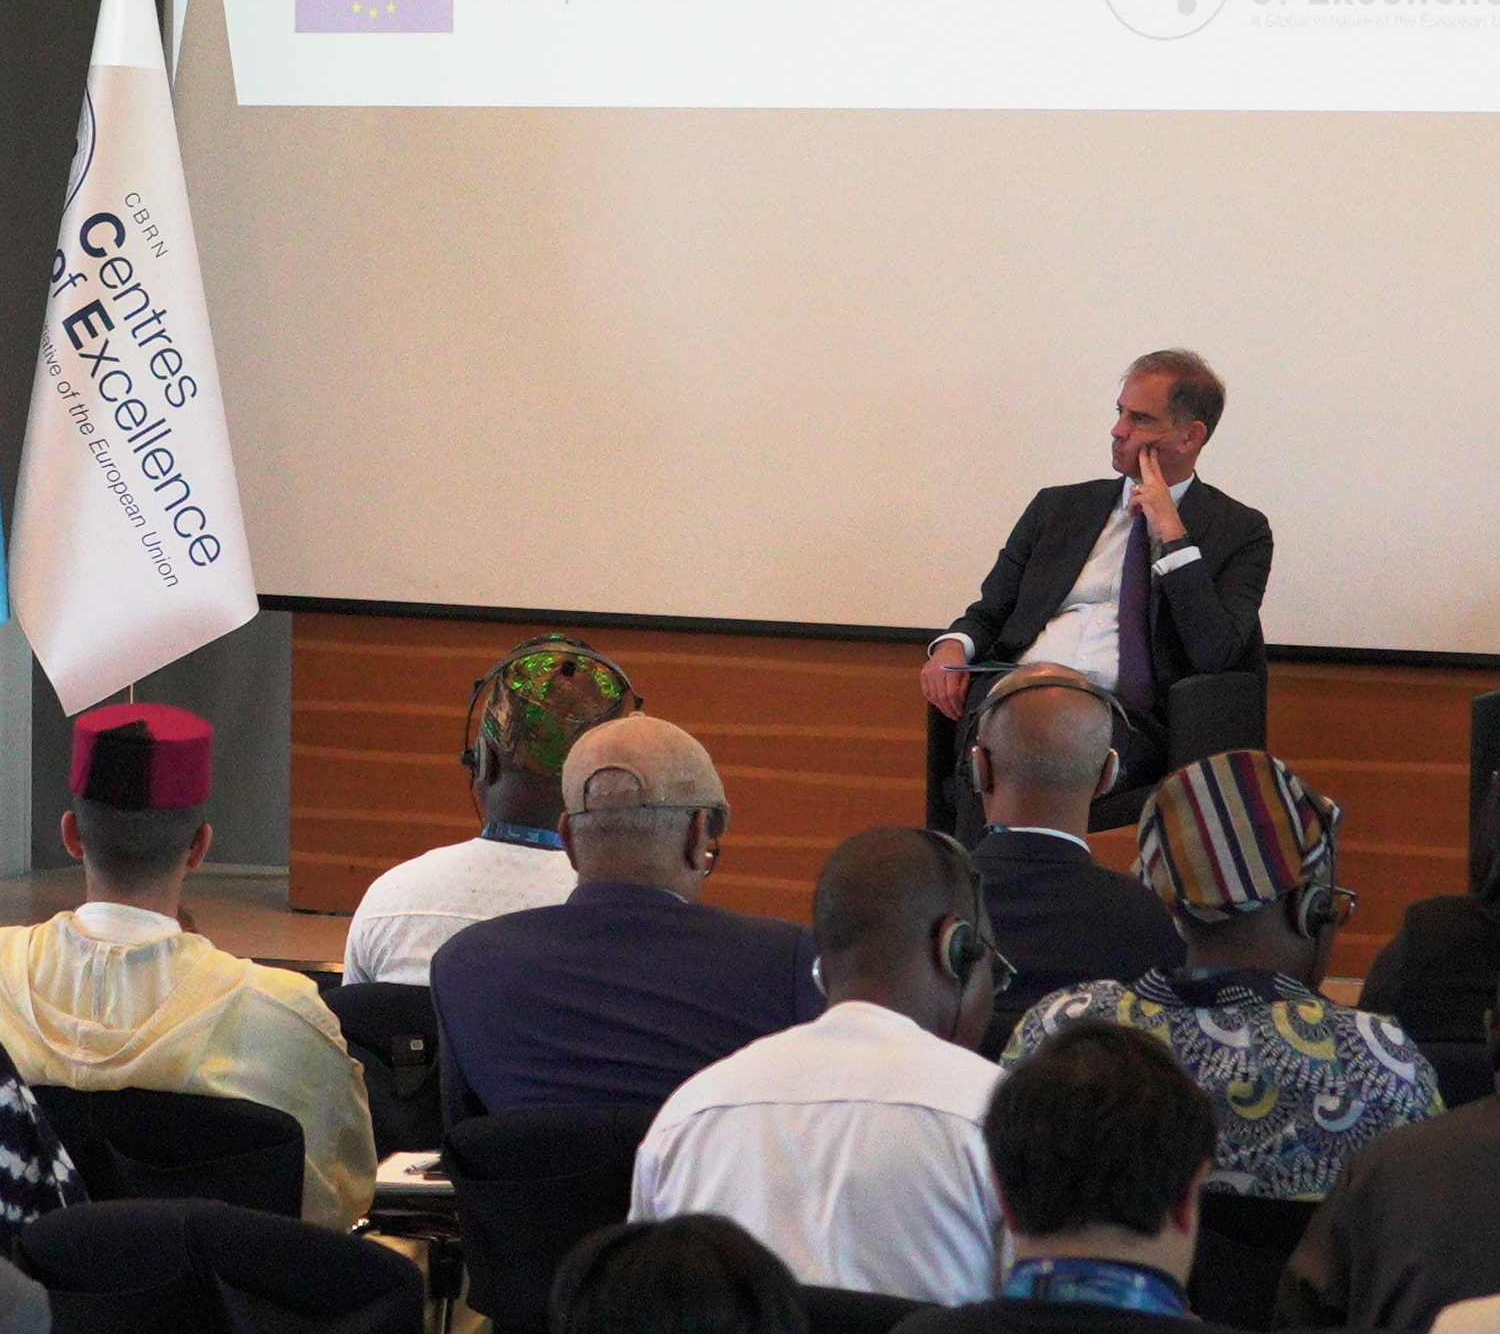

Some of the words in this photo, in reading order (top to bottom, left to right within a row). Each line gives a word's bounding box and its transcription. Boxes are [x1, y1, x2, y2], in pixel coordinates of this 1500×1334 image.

[1265, 13, 1309, 28] Global
[52, 248, 88, 298] of
[125, 192, 168, 258] CBRN
[79, 212, 198, 408] Centres
[57, 381, 80, 400] of
[69, 403, 95, 435] the
[89, 438, 146, 528] European
[142, 531, 179, 588] Union
[62, 299, 221, 568] Excellence
